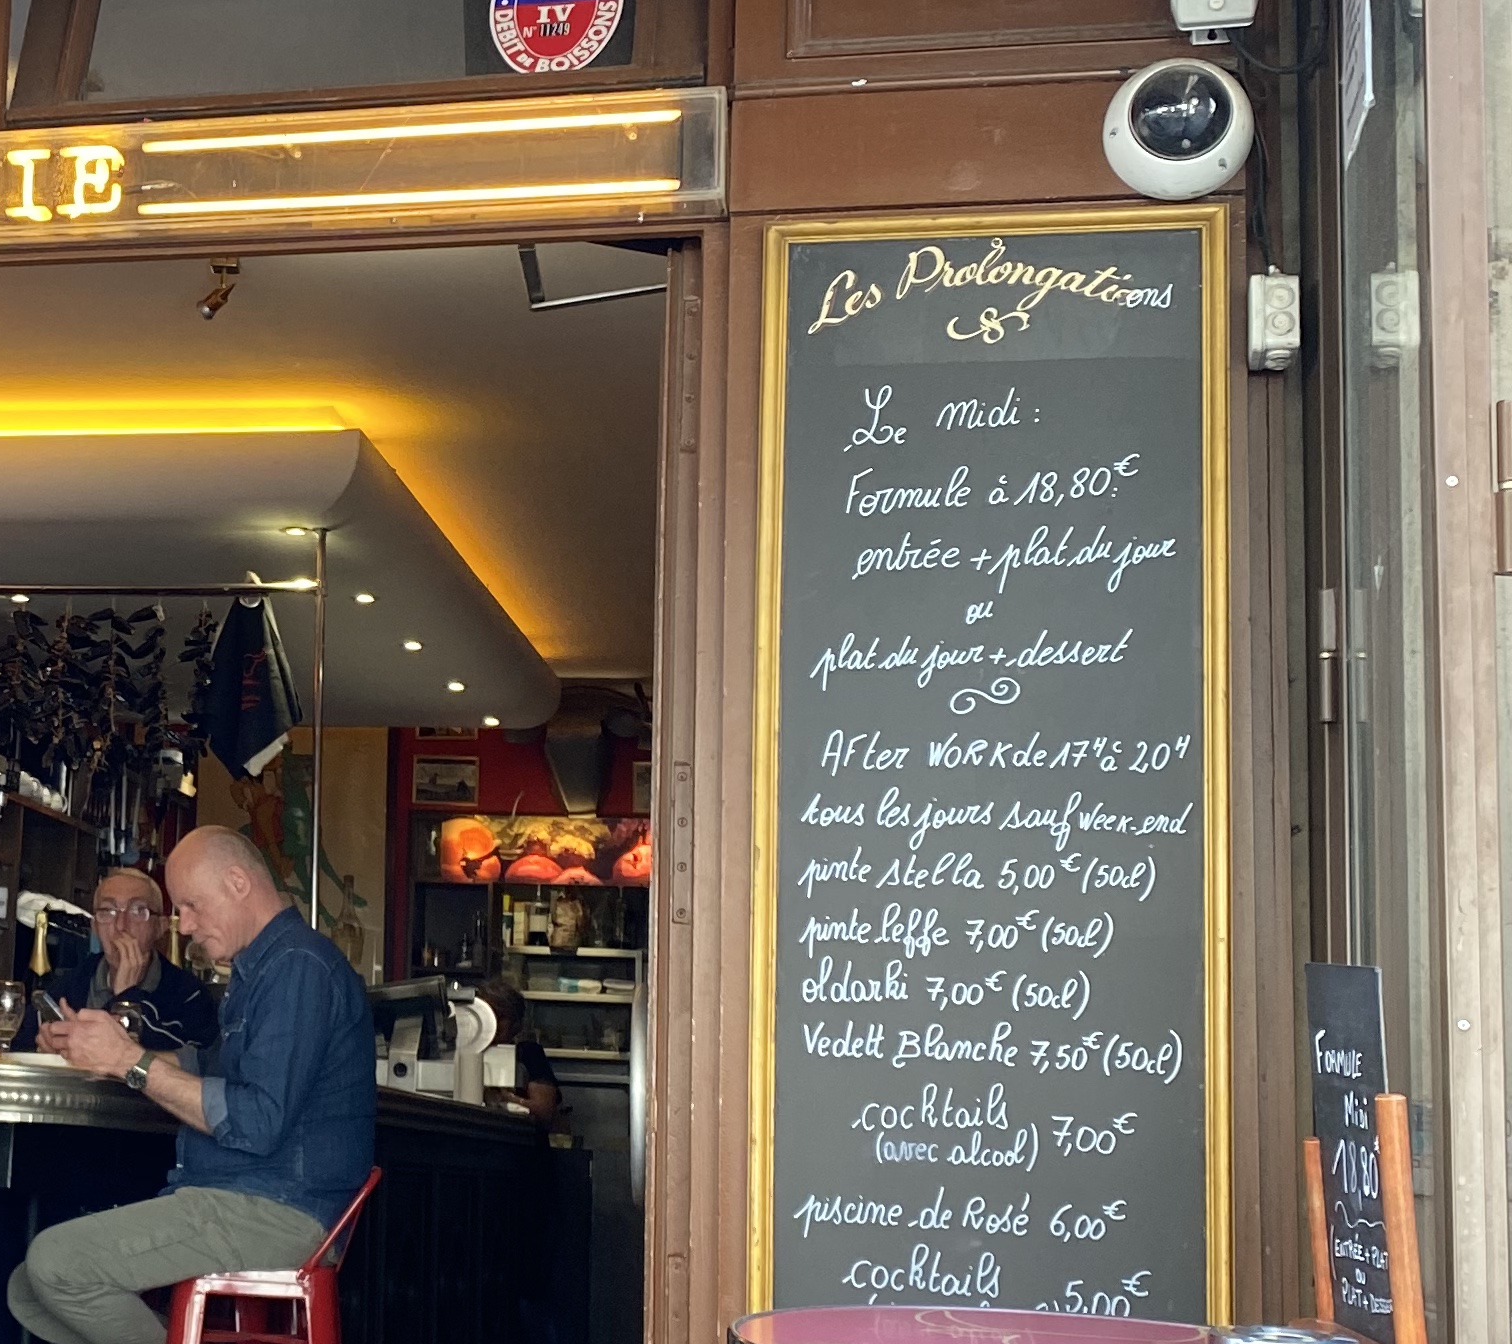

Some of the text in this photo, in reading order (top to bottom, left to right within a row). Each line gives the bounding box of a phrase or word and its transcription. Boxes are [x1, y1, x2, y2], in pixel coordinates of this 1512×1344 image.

[494, 8, 526, 55] DEBIT
[535, 0, 617, 73] BOISSONS
[536, 3, 576, 23] IV
[539, 22, 570, 37] 11249
[808, 237, 1173, 334] Les Prolongations
[844, 385, 907, 452] Le
[846, 466, 971, 516] Formule
[988, 475, 1009, 504] à
[852, 532, 960, 580] entrée
[987, 526, 1074, 594] plat
[1067, 525, 1112, 568] du
[1107, 536, 1177, 592] jour
[965, 601, 994, 624] ou
[810, 632, 880, 691] plat
[878, 635, 917, 670] du
[916, 642, 984, 687] jour
[1004, 629, 1133, 667] dessert
[1013, 732, 1046, 767] de
[801, 792, 865, 826] tous
[877, 787, 909, 827] les
[909, 798, 994, 850] jours
[999, 791, 1082, 851] sauf
[797, 846, 873, 899] pinte
[799, 908, 870, 958] pinte
[802, 1020, 885, 1059] Vedett
[892, 1021, 1019, 1069] Blanche
[793, 1194, 903, 1238] piscine
[908, 1186, 951, 1229] de
[962, 1193, 1030, 1236] Rosé
